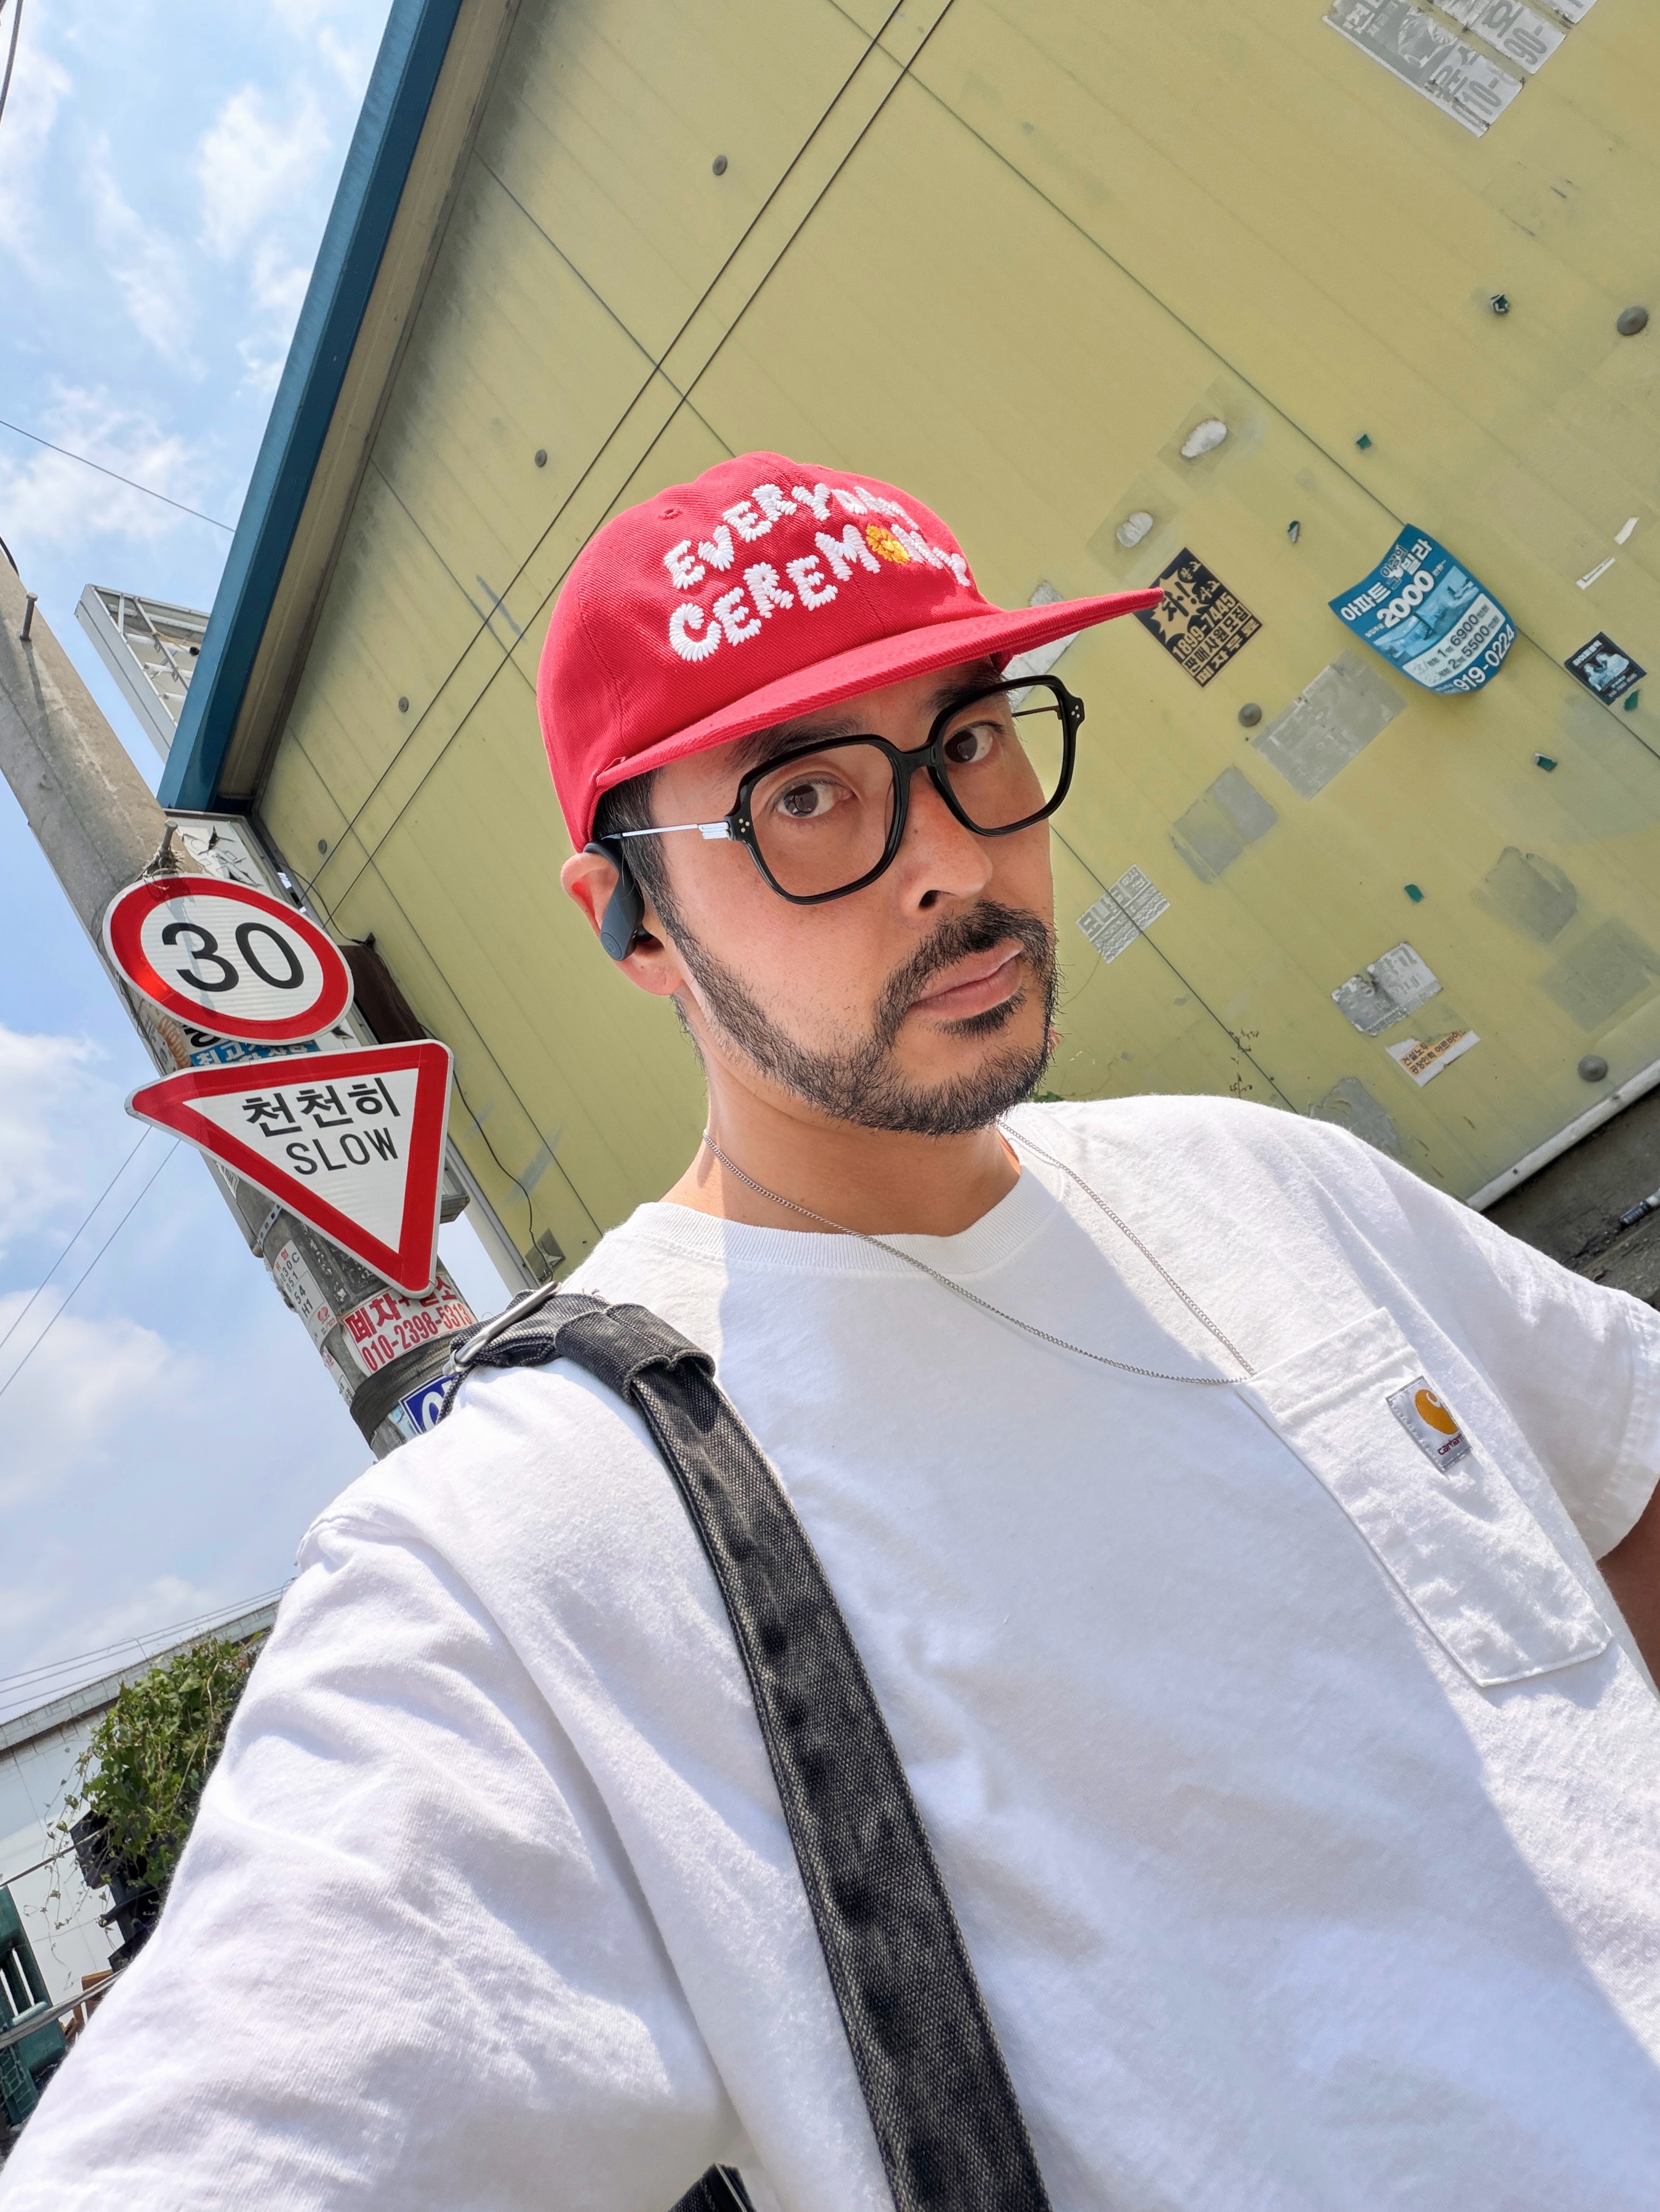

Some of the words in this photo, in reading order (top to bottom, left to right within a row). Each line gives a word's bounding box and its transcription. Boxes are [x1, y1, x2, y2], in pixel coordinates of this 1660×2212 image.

[669, 523, 971, 662] CEREMONY
[1341, 581, 1391, 621] 아파트
[1401, 538, 1433, 575] 빌라
[1172, 592, 1236, 660] 1899-7445
[1185, 606, 1249, 673] 판매사원모집
[1453, 624, 1515, 690] 919-0224
[161, 922, 304, 992] 30
[241, 1078, 400, 1137] 천천히
[286, 1127, 398, 1175] SLOW
[362, 1303, 473, 1371] 010-2398-5313
